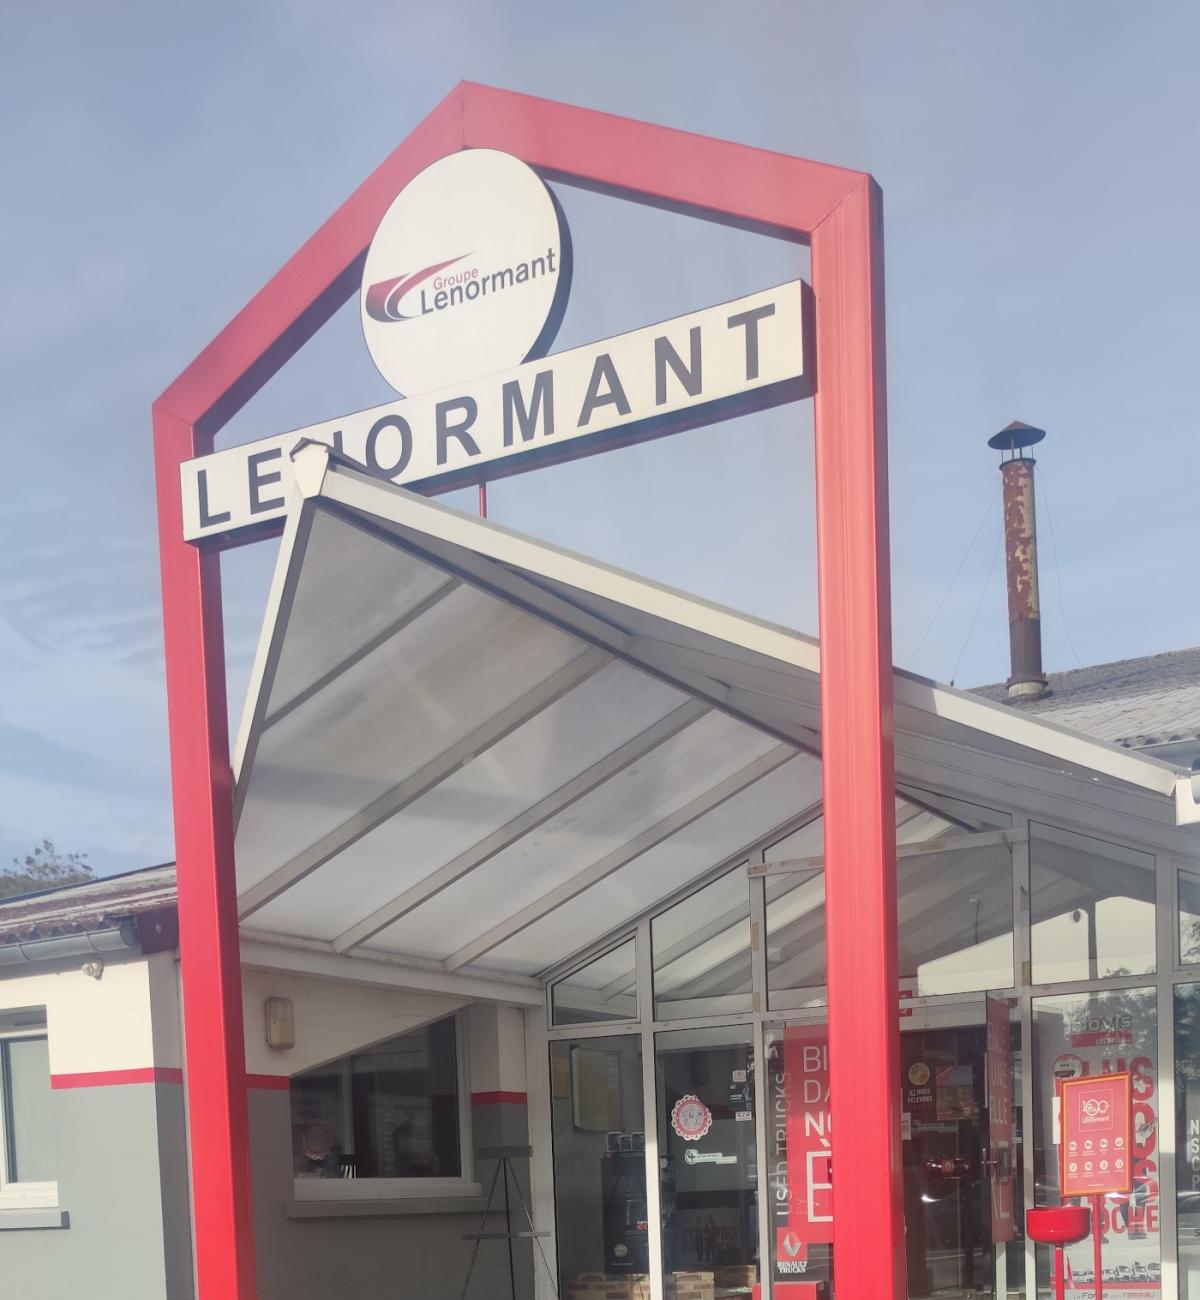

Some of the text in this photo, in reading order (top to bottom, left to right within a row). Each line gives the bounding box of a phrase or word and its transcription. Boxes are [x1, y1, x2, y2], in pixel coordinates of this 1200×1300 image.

[420, 247, 556, 315] Lenormant
[433, 267, 479, 290] Groupe
[805, 1111, 831, 1137] N
